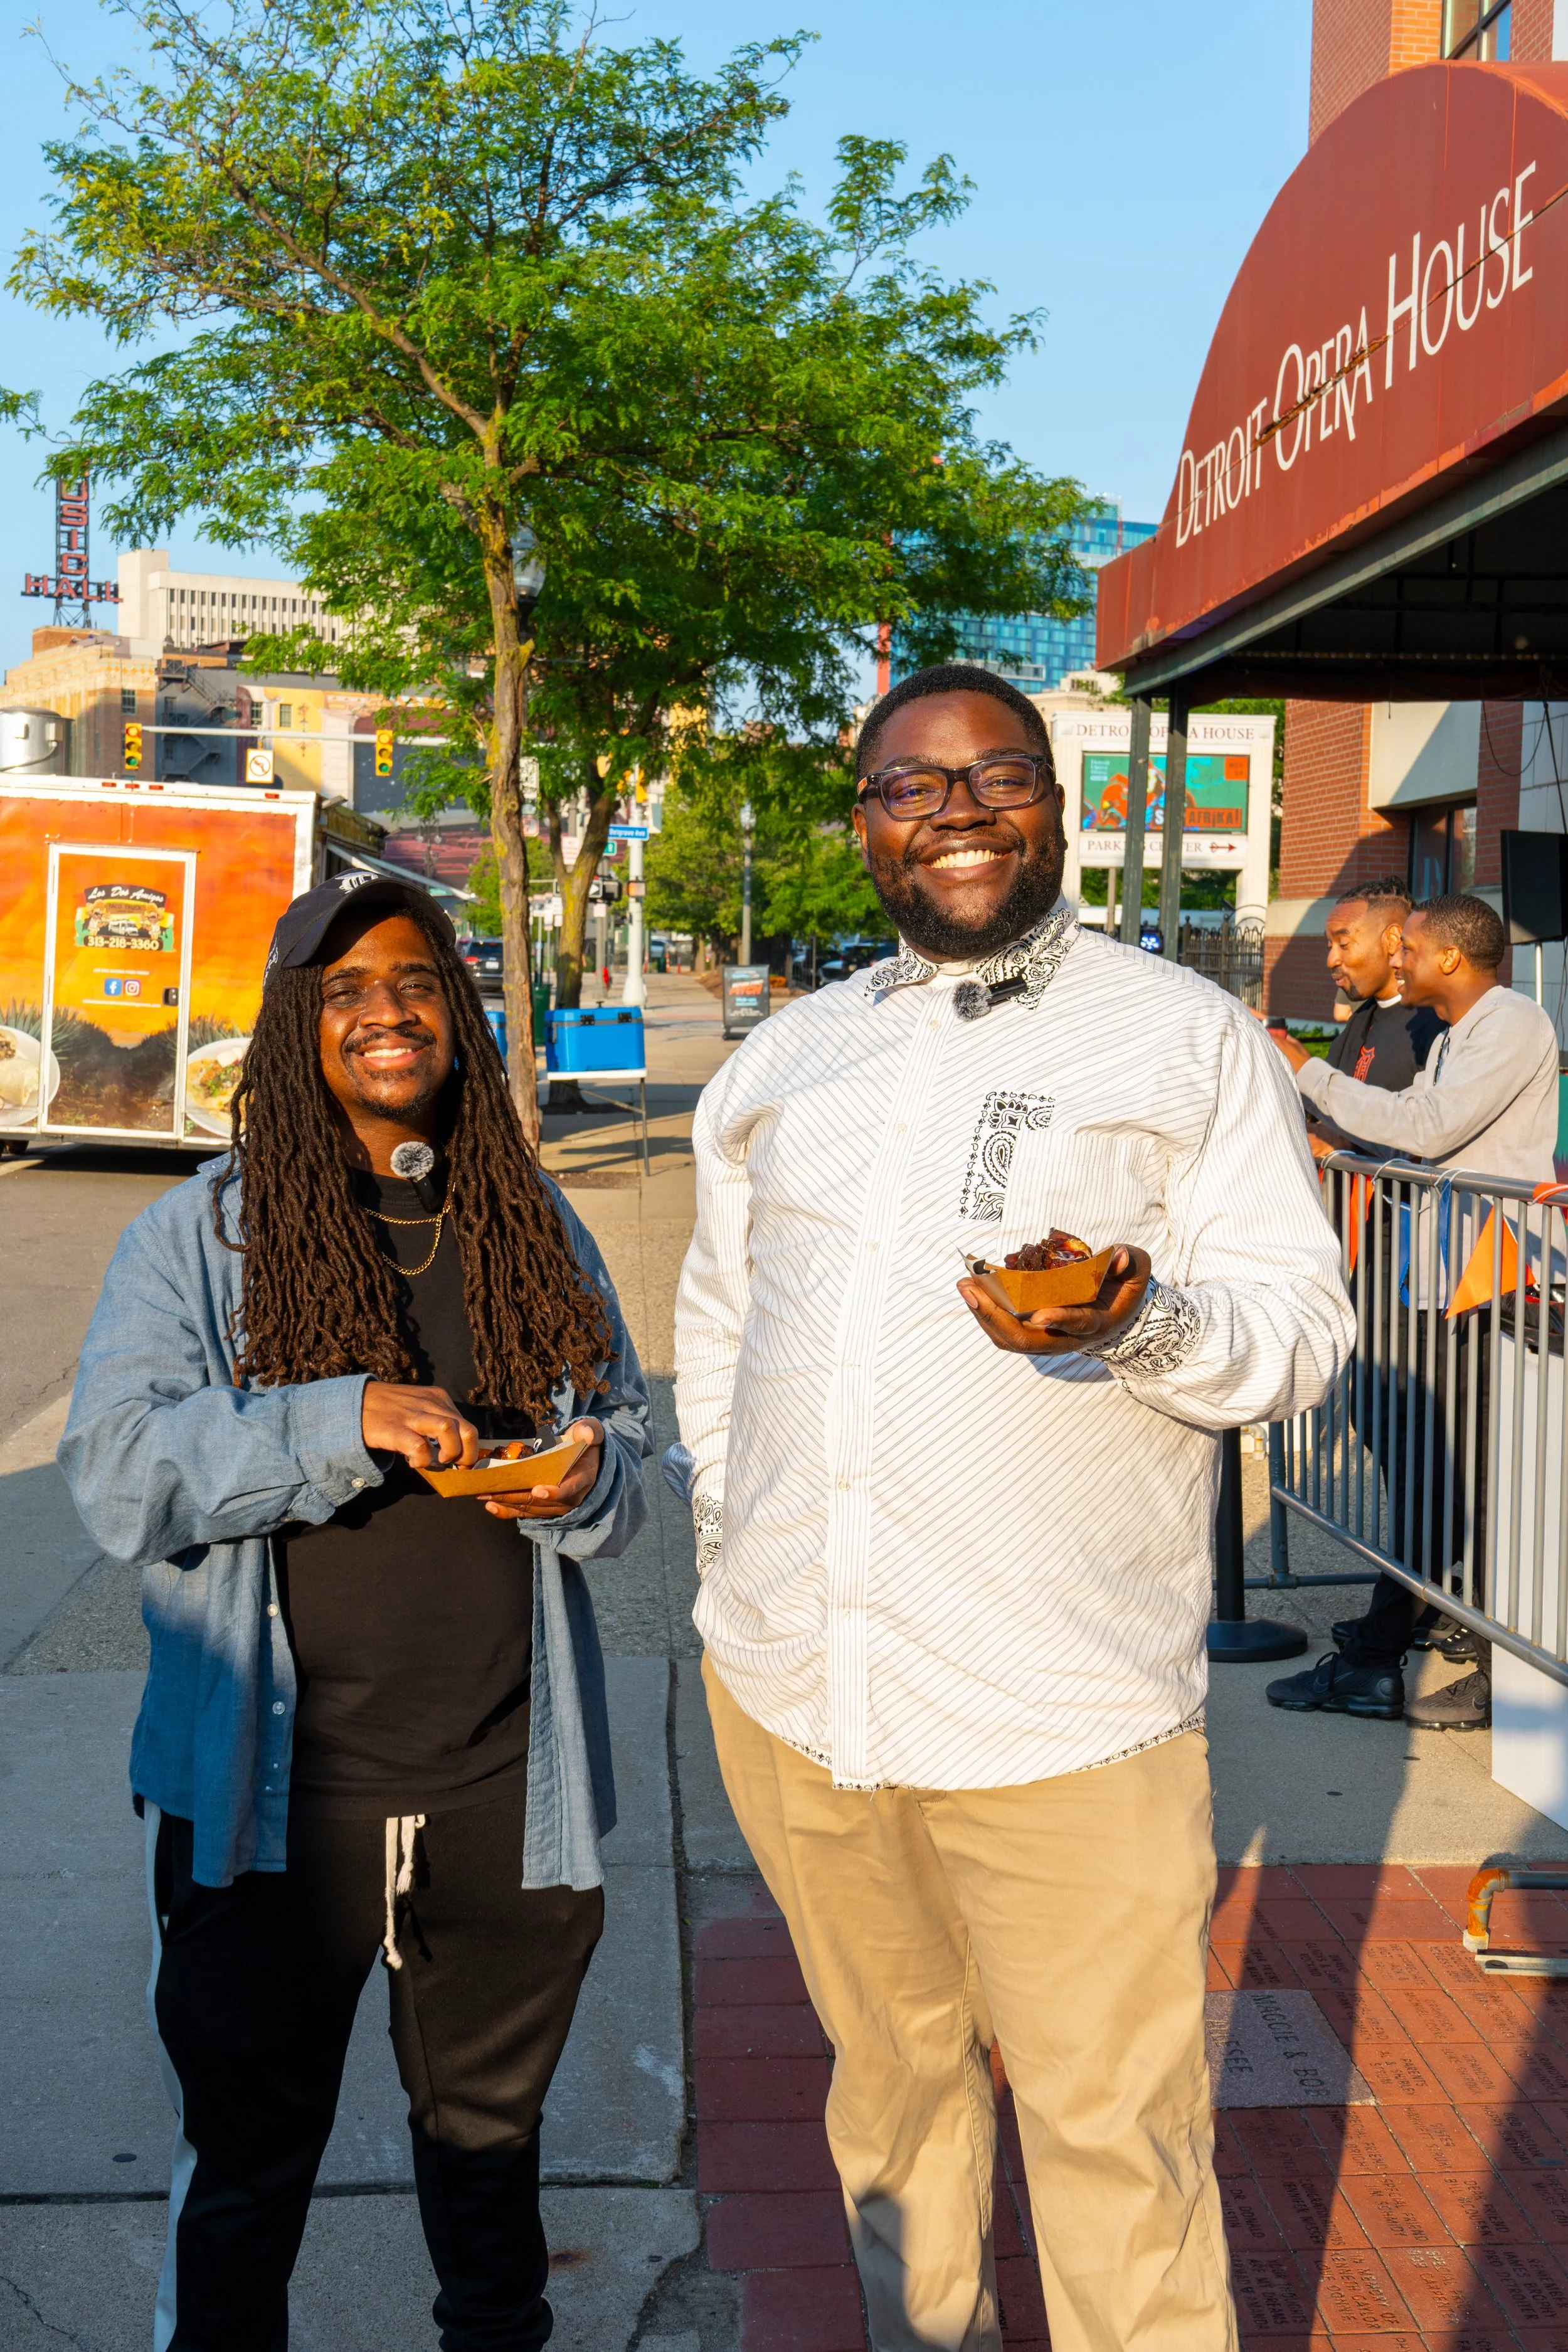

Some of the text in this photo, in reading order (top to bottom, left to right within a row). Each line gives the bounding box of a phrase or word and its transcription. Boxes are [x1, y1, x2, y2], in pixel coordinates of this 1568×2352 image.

[1175, 160, 1537, 548] DETROIT OPERA HOUSE
[61, 458, 88, 575] USIC
[25, 573, 124, 603] HALL
[1076, 724, 1129, 736] DETRO
[1204, 728, 1254, 740] HOUSE
[88, 886, 164, 903] Los Dos Amigos
[88, 936, 159, 950] 313-218-3360
[1349, 1993, 1391, 2040] SPECIAL FRIEND
[1423, 2000, 1457, 2031] GRANDSON
[1202, 2020, 1255, 2073] ALLESEE
[1249, 1994, 1333, 2097] MAGGIE & BOB
[1389, 2069, 1419, 2095] SHIRLEY
[1399, 2058, 1429, 2086] PARENTS
[1453, 2067, 1485, 2095] SHIROCK
[1461, 2055, 1497, 2089] GRANDSON
[1533, 2053, 1568, 2089] GRANDSON
[1342, 2111, 1389, 2169] SPECIAL FRIEND
[1343, 2144, 1372, 2170] BRIGHT
[1429, 2123, 1457, 2147] SISTER
[1479, 2105, 1533, 2164] HAPPY BIRTHDAY
[1501, 2112, 1546, 2157] BOB PASTOR
[1229, 2189, 1266, 2238] DR DONALD
[1280, 2181, 1327, 2245] JENNIFER NASSER
[1298, 2179, 1347, 2245] CONGRATULATIONS
[1364, 2185, 1408, 2236] JIM SCHMIDT
[1379, 2179, 1430, 2241] SPECIAL FRIEND
[1443, 2178, 1494, 2236] BILL MCQUEEN
[1462, 2181, 1512, 2232] DEAR FRIEND
[1253, 2277, 1273, 2287] MY
[1312, 2260, 1357, 2321] LOVE DONNIE
[1327, 2252, 1361, 2291] KENNETH
[1349, 2295, 1382, 2328] GAYLOR
[1348, 2255, 1401, 2324] IN MEMORY OF
[1424, 2250, 1459, 2286] SPECIAL
[1480, 2250, 1541, 2319] PRO DETROITER
[1500, 2251, 1532, 2277] JAMES
[1522, 2283, 1560, 2318] BROPHY
[1525, 2259, 1568, 2308] REMEMBER
[1241, 2296, 1273, 2330] AMANDA
[1259, 2292, 1290, 2324] DREAMS
[1275, 2283, 1311, 2324] THOUGHTS
[1417, 2273, 1461, 2324] CARPENTER
